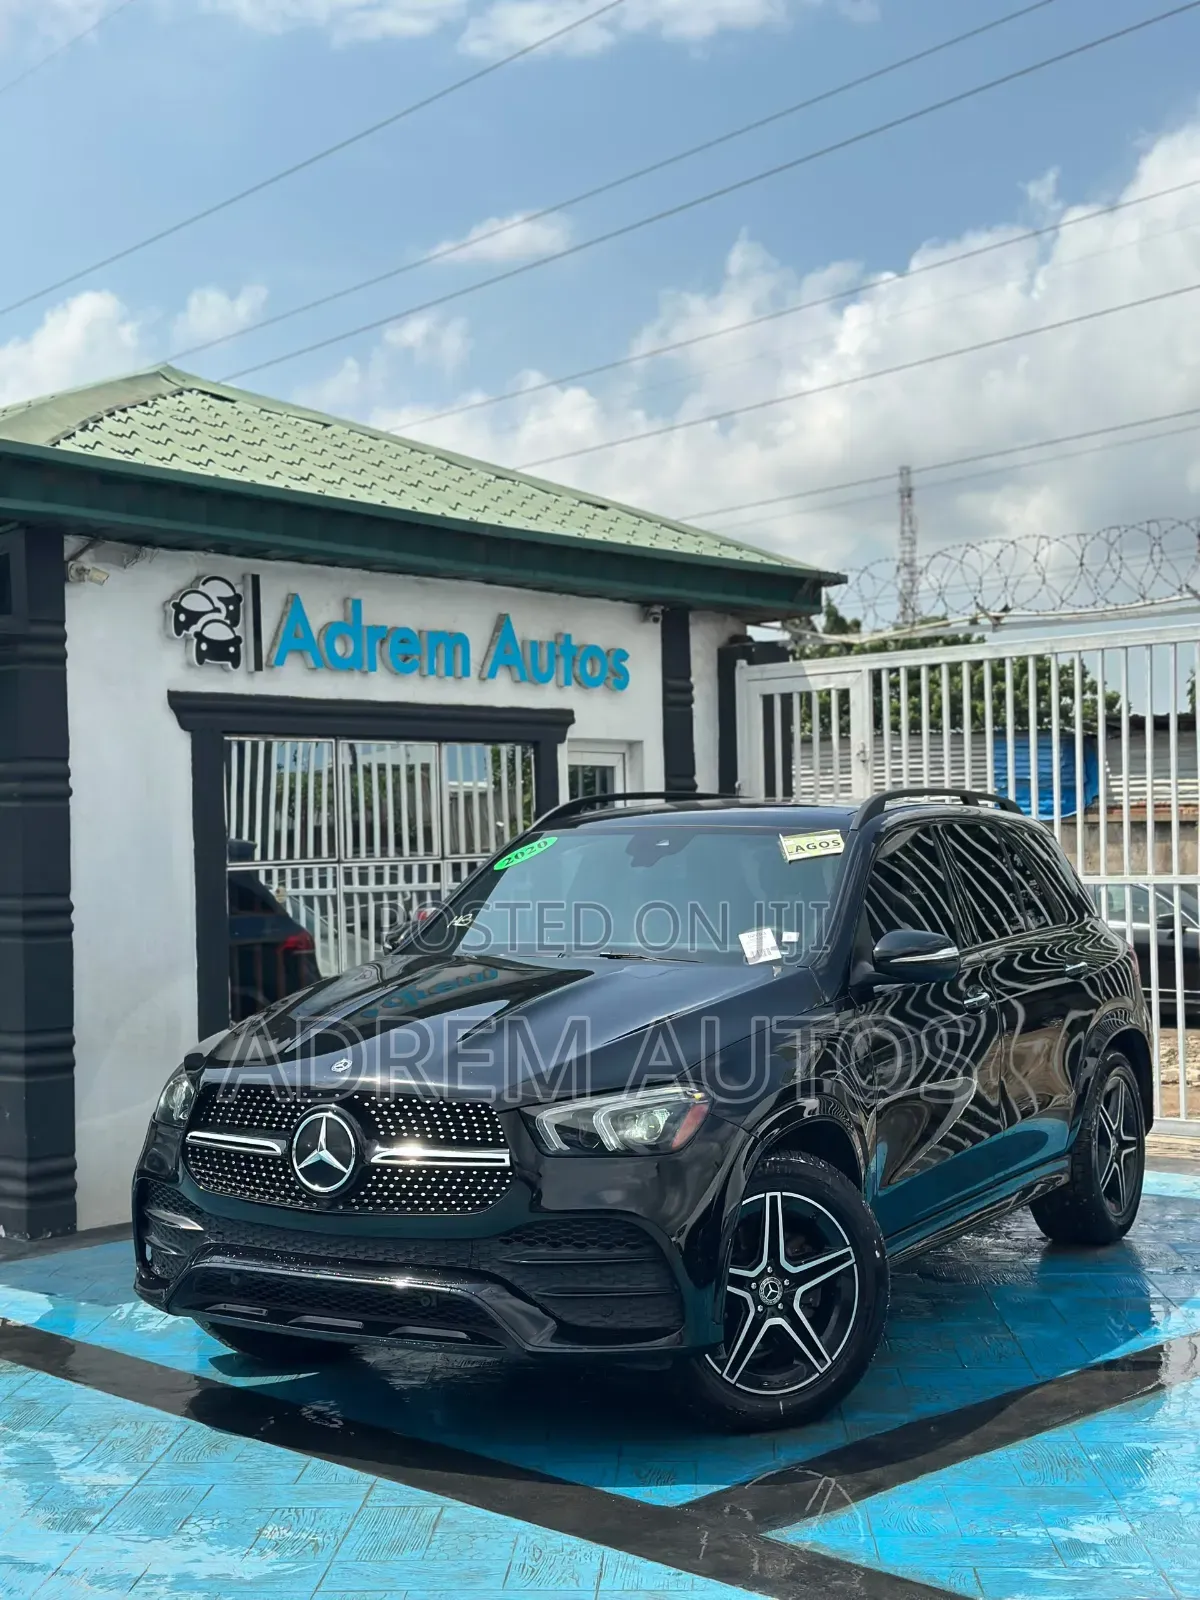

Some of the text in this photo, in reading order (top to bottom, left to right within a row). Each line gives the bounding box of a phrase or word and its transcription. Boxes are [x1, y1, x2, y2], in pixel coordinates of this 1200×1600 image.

[268, 592, 630, 691] Adrem Autos
[502, 840, 548, 866] 2020
